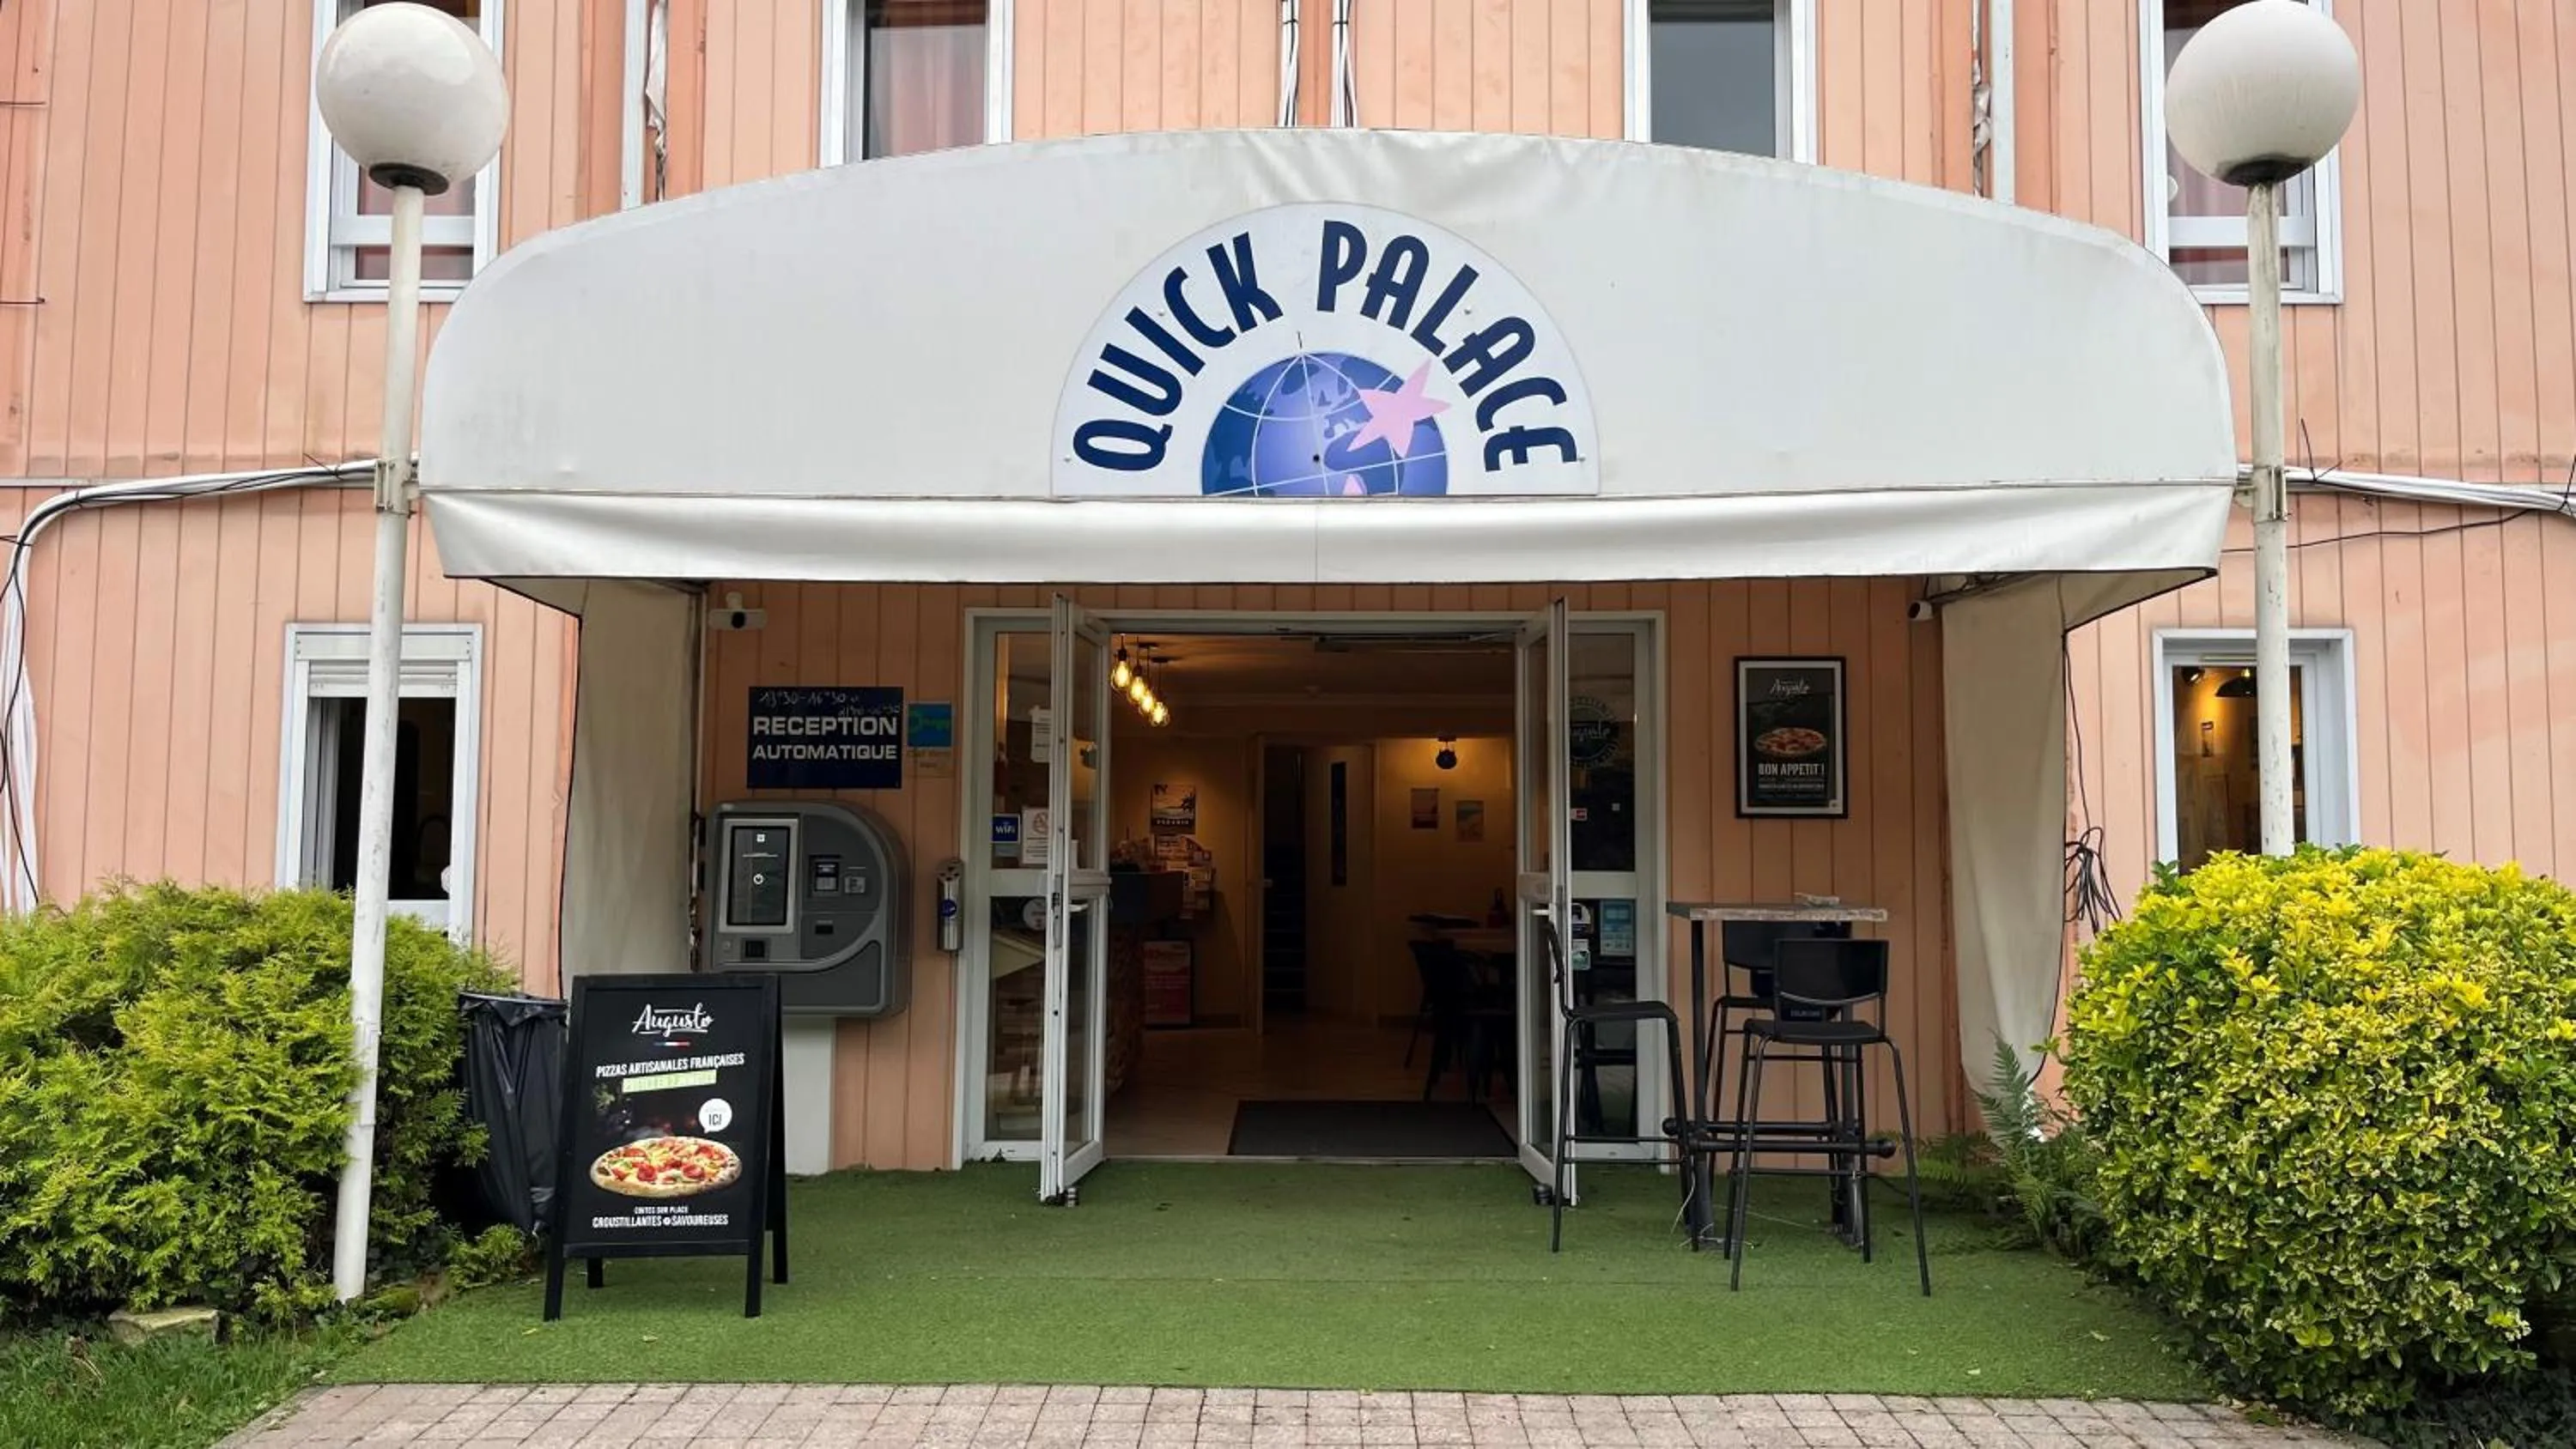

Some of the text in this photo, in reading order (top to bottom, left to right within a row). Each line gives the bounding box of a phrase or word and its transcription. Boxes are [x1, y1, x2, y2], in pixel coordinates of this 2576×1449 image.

[1072, 220, 1578, 472] QUICK PALACE
[752, 716, 897, 737] RECEPTION
[752, 744, 897, 761] AUTOMATIQUE
[1758, 762, 1778, 776] BON
[631, 1003, 714, 1038] Augusto
[596, 1052, 745, 1078] PIZZAS ARTISANALES FRANÇAISES
[708, 1113, 722, 1126] ICI
[671, 1214, 729, 1228] SAVOUREUSES
